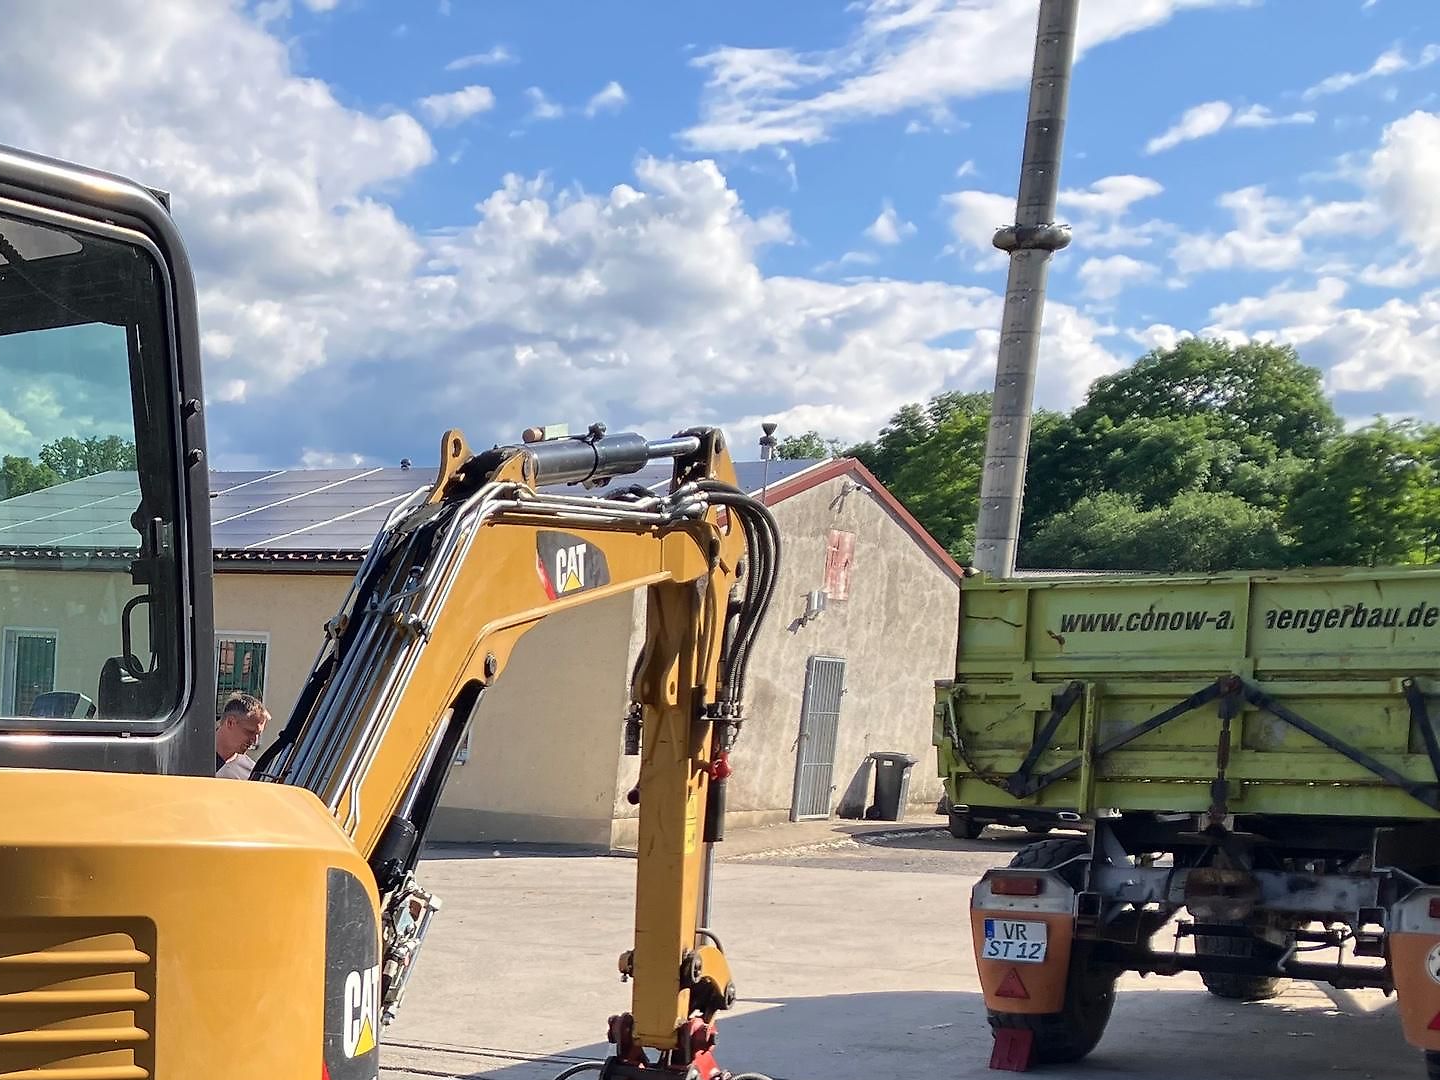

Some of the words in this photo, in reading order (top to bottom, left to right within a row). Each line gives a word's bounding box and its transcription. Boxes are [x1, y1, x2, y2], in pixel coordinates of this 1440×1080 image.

[556, 544, 587, 593] CAT
[1003, 923, 1027, 940] VR
[988, 941, 1014, 957] ST
[1016, 943, 1041, 959] 12
[344, 965, 379, 1059] CAT
